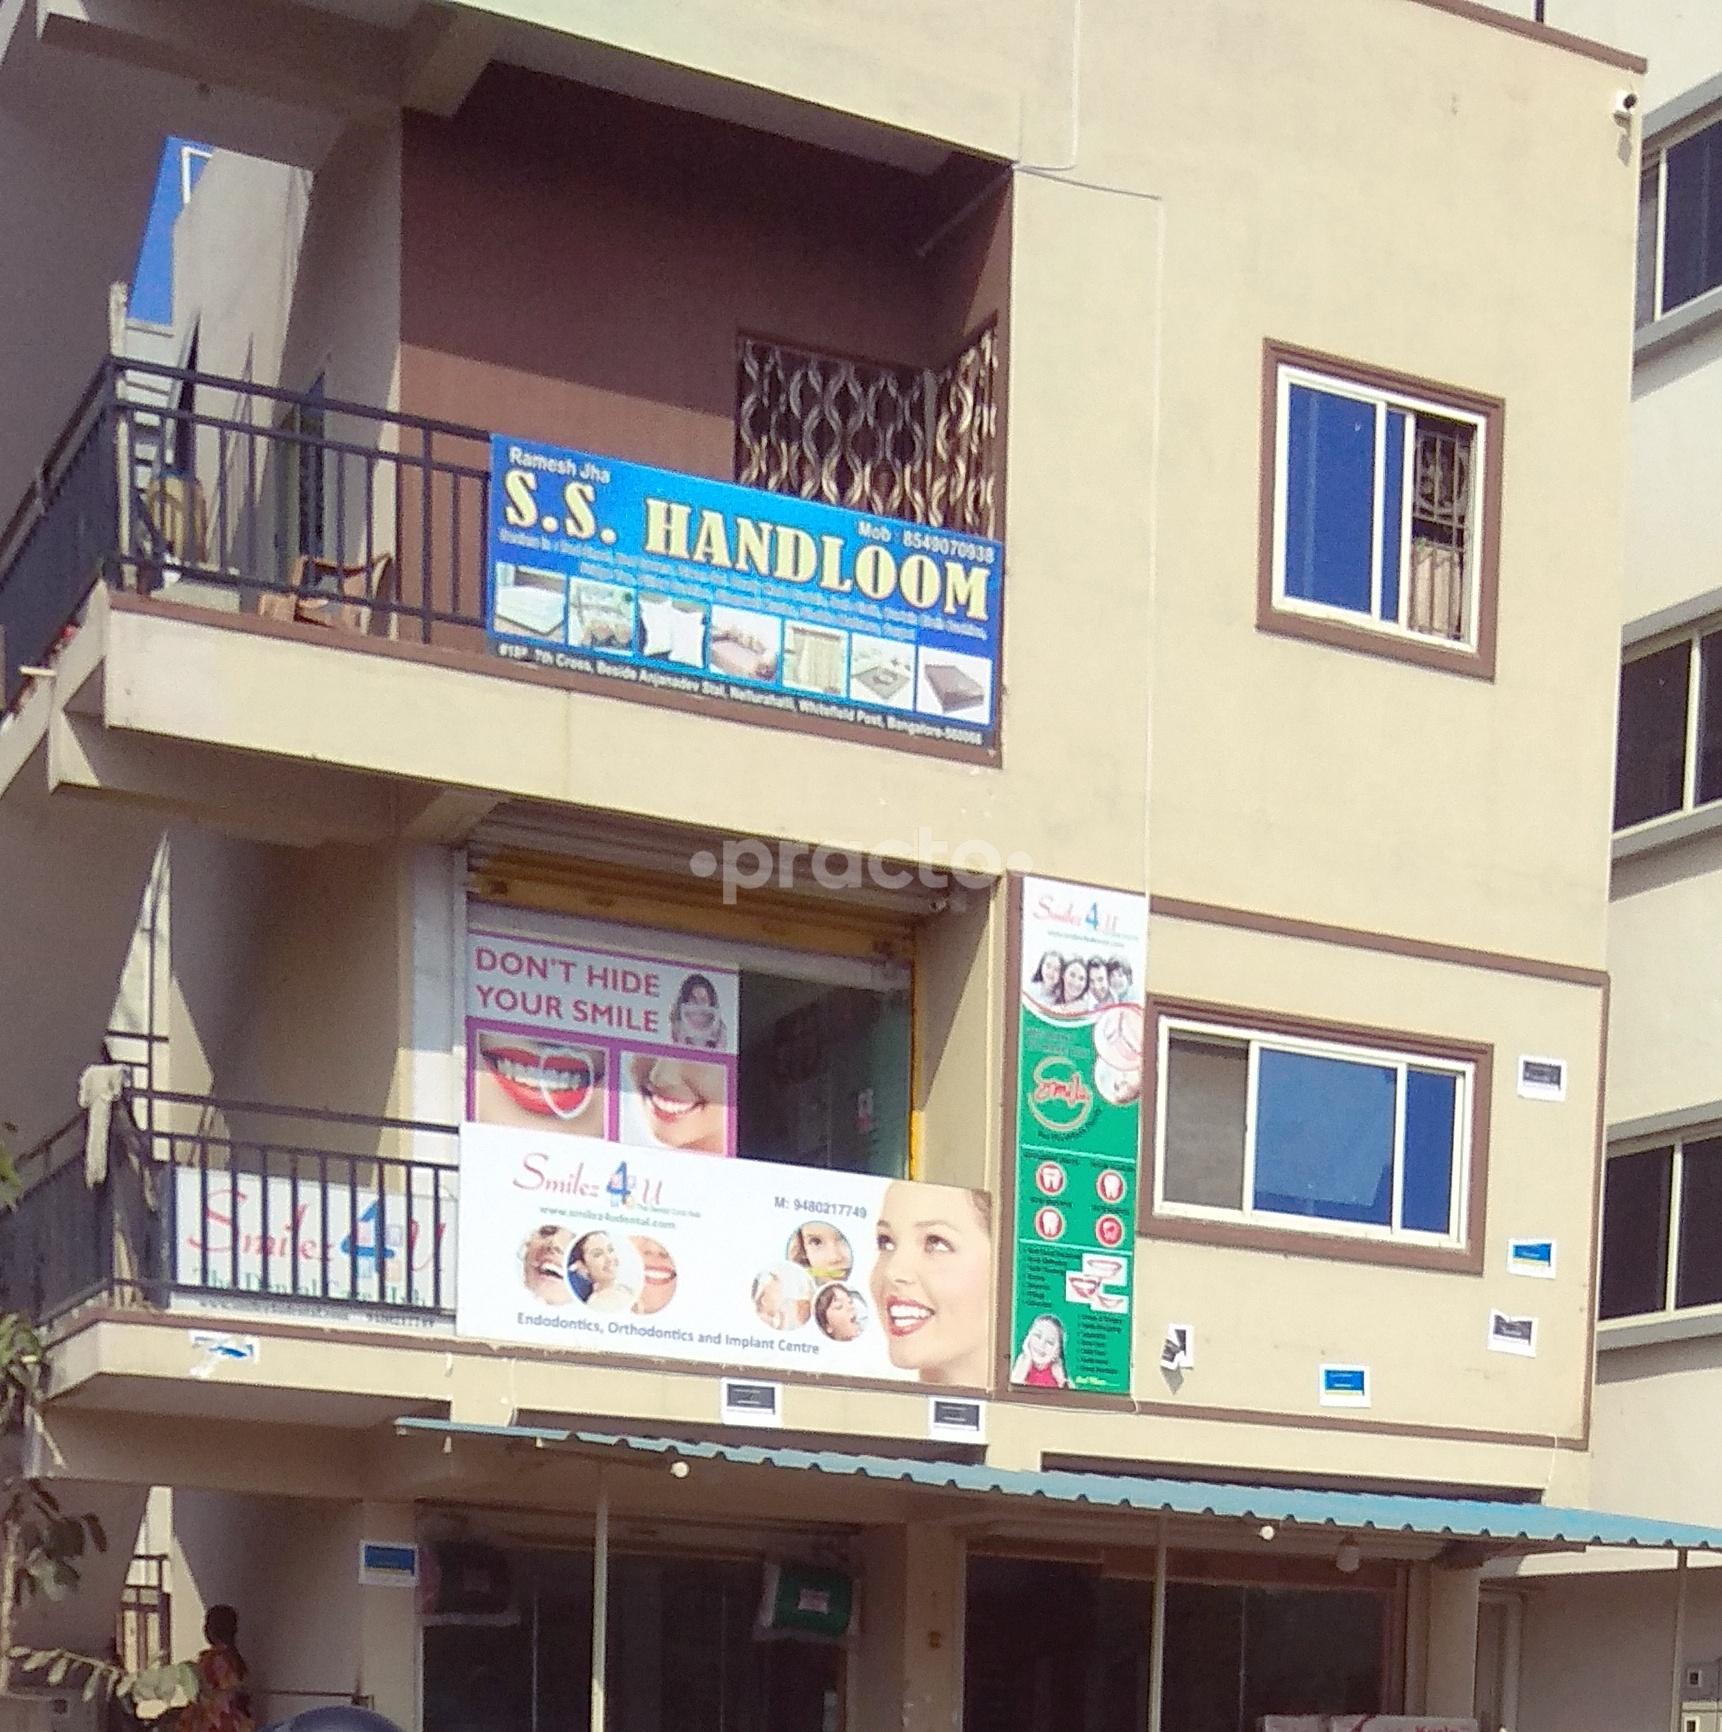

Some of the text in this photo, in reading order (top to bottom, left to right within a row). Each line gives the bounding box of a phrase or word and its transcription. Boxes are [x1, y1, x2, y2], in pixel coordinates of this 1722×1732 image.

[508, 446, 612, 485] Ramesh Jha
[505, 469, 990, 621] S.S. HANDLOOM
[1085, 901, 1099, 931] 4
[474, 946, 660, 998] DON'T HIDE
[475, 983, 660, 1033] YOUR SMILE
[606, 1160, 632, 1205] 4
[516, 1311, 820, 1355] Endodontics, Orthodontics and Implant Centre
